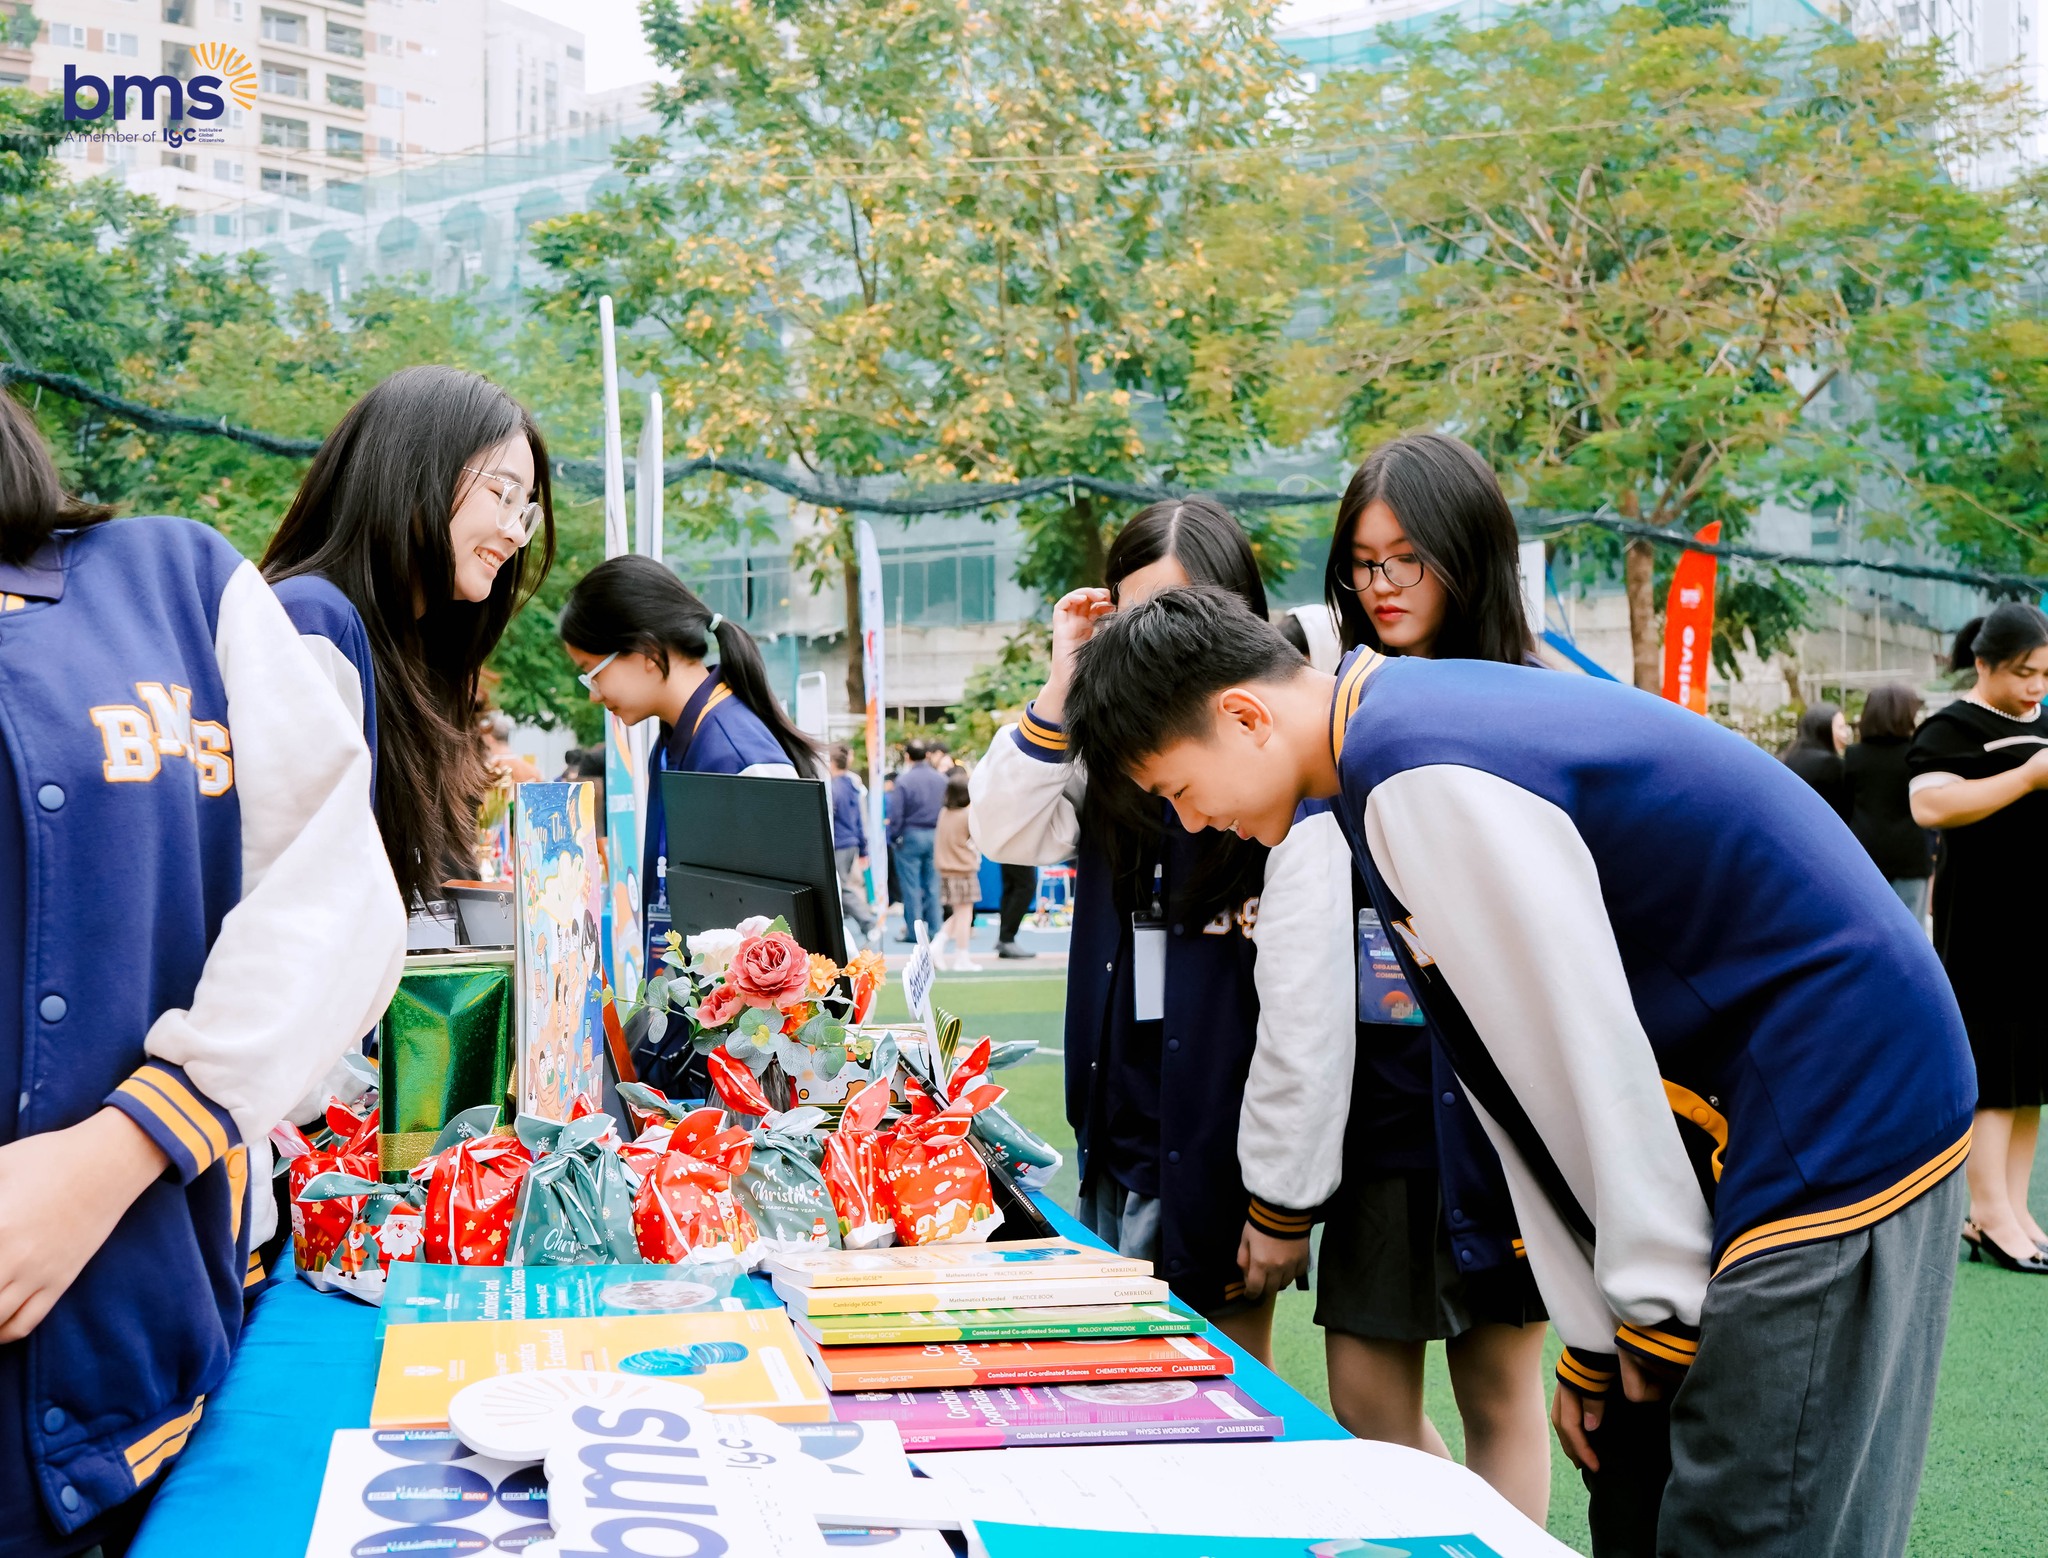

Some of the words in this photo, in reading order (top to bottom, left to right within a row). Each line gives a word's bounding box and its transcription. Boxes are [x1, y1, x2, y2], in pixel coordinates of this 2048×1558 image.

[89, 682, 234, 797] BMS
[1375, 971, 1406, 980] COMMITT
[503, 1269, 526, 1293] Sciences
[835, 1275, 862, 1283] Cambridge
[1100, 1266, 1138, 1274] CAMBRIDGE
[478, 1279, 500, 1291] and
[476, 1291, 500, 1321] Combined
[833, 1301, 861, 1309] Cambridge
[1113, 1289, 1153, 1298] CAMBRIDGE
[848, 1332, 878, 1340] Cambridge
[1148, 1324, 1191, 1332] CAMBRIDGE
[513, 1343, 537, 1373] ematics
[944, 1343, 981, 1366] Co-ord
[858, 1376, 888, 1384] Cambridge
[987, 1371, 1016, 1379] Combined
[1029, 1370, 1065, 1378] Co-ordinated
[1095, 1367, 1128, 1375] CHEMISTRY
[1171, 1364, 1216, 1373] CAMBRIDGE
[1016, 1431, 1048, 1440] Combined
[1049, 1431, 1060, 1439] and
[1061, 1430, 1101, 1438] Co-ordinated
[1102, 1429, 1128, 1437] Sciences
[1135, 1428, 1162, 1436] PHYSICS
[1162, 1426, 1200, 1435] WORKBOOK
[1216, 1424, 1265, 1434] CAMBRIDGE
